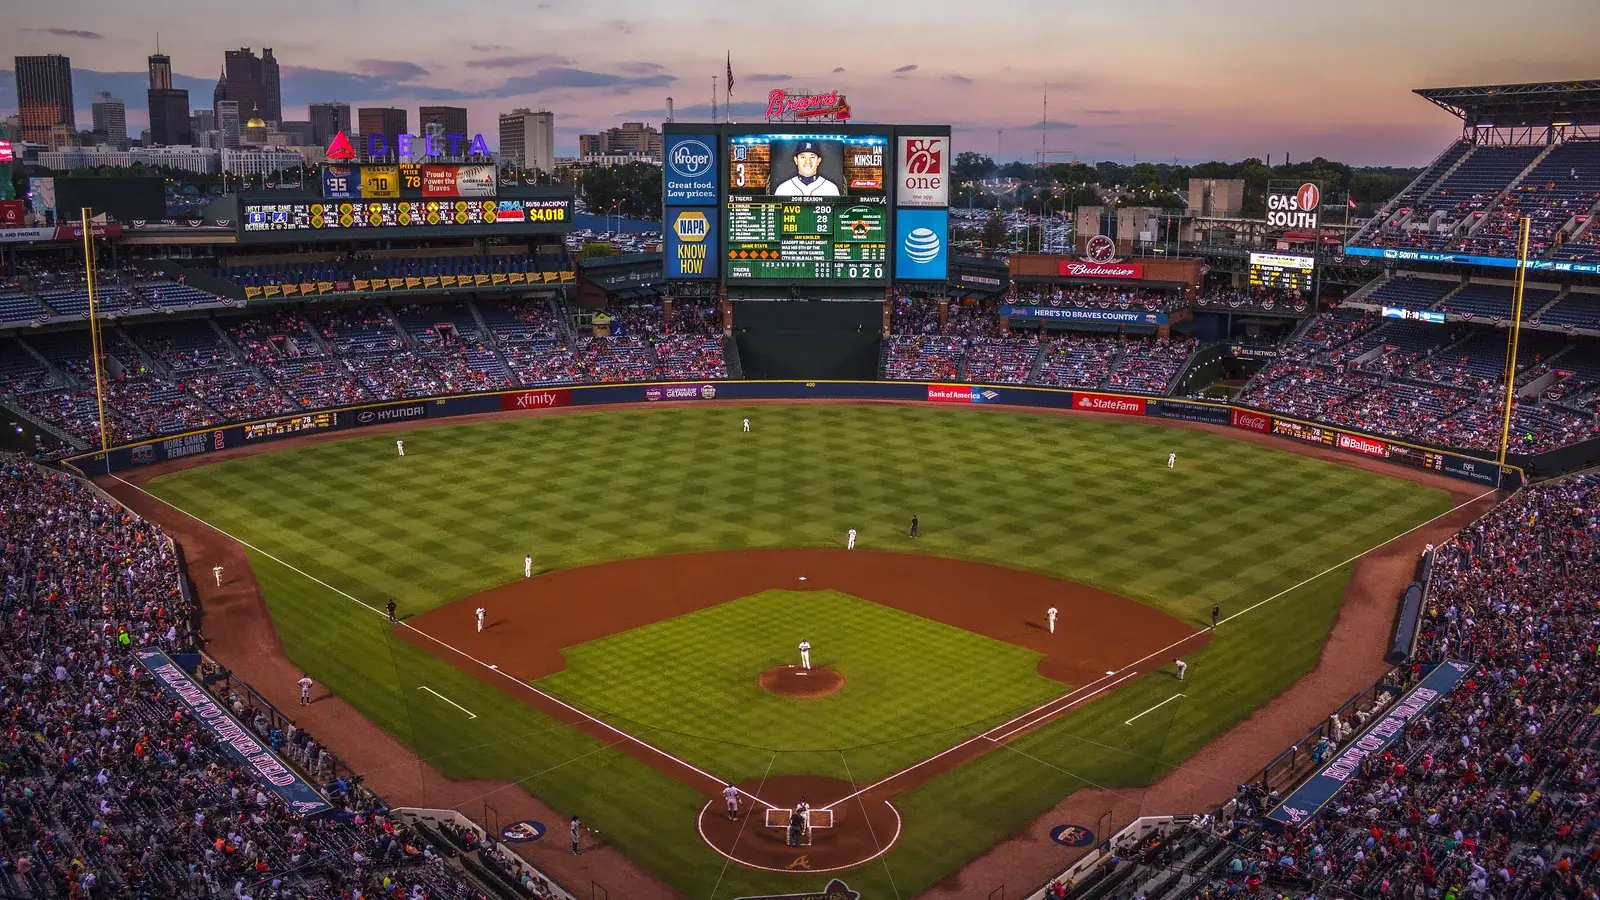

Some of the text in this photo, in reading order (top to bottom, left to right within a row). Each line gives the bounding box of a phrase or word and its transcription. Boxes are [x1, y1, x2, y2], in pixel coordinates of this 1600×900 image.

[765, 89, 837, 120] Braves
[368, 134, 490, 157] DELTA
[872, 146, 882, 154] IAN
[674, 147, 708, 172] Kroger
[854, 155, 882, 166] KINSLER
[406, 176, 421, 188] 78
[736, 164, 745, 187] 3
[327, 178, 346, 191] $35
[368, 178, 387, 190] $70
[906, 178, 940, 189] one
[687, 190, 715, 198] prices.
[1268, 195, 1298, 210] GAS
[530, 208, 564, 221] $4,018
[1267, 212, 1316, 228] SOUTH
[680, 220, 704, 234] NAPA
[678, 245, 706, 258] KNOW
[681, 259, 703, 273] HOW
[849, 268, 882, 278] 0 2 0
[1068, 263, 1134, 276] Budweiser
[1102, 313, 1138, 321] COUNTRY
[517, 393, 556, 407] xfinity
[953, 391, 980, 399] America
[378, 406, 424, 420] HYUNDAI
[164, 433, 208, 450] HOME GAMES
[214, 430, 224, 449] 2
[1350, 438, 1384, 454] Ballpark
[168, 443, 205, 459] REMAINING
[1445, 466, 1493, 481] NORTHSIDE HOSPITAL
[154, 663, 295, 786] WELCOME TO TURNER FIELD
[1322, 687, 1438, 781] HOME OF THE BRAVES
